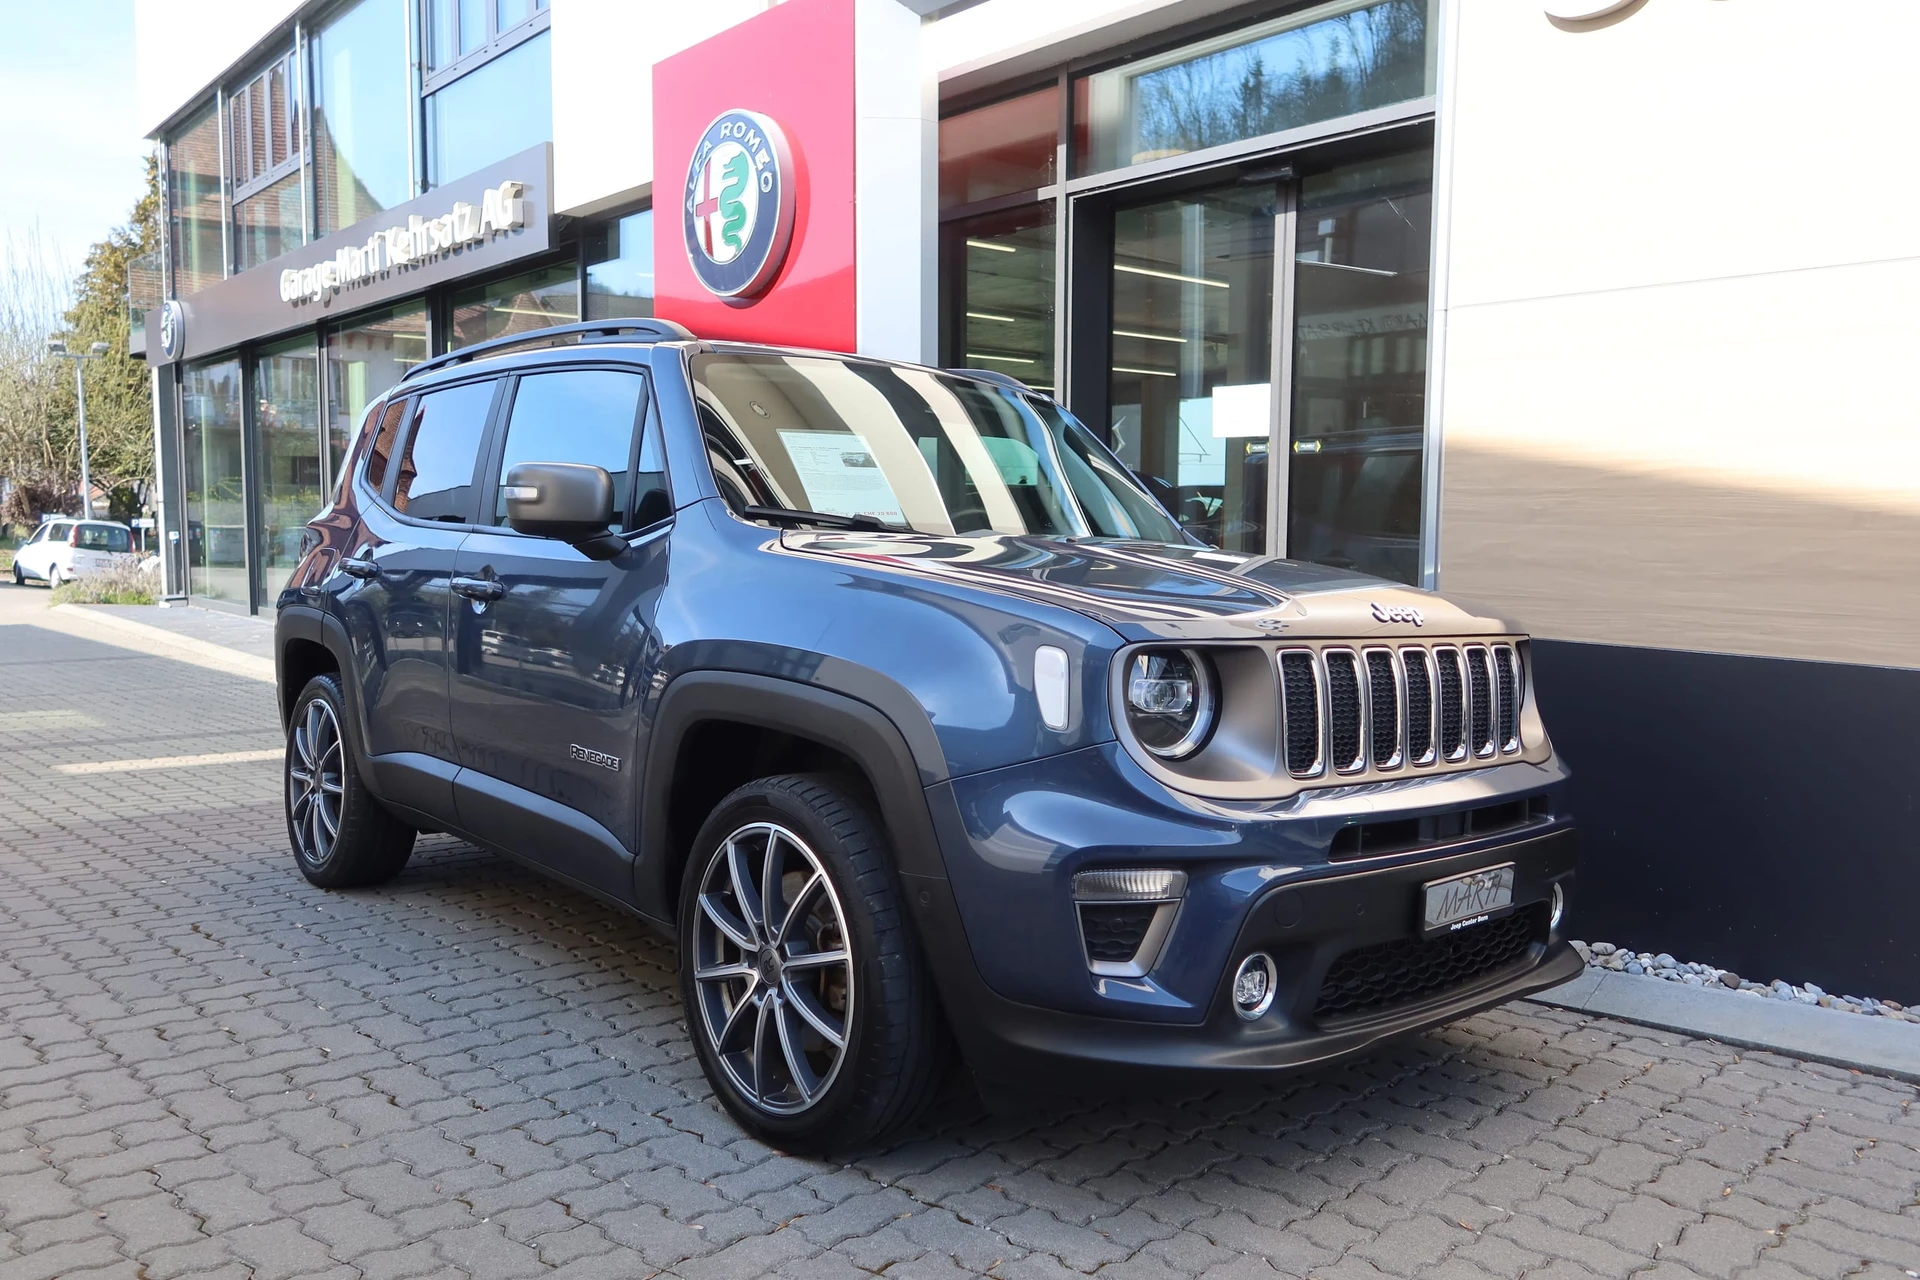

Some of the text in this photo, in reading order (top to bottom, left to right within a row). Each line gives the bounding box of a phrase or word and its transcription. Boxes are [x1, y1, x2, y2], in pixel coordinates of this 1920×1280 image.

[686, 121, 773, 213] ALFA ROMEO
[280, 266, 337, 302] Garage
[384, 201, 483, 268] Kehrsatz
[479, 180, 525, 236] AG
[1370, 602, 1424, 627] Jeep
[570, 743, 621, 772] RENEGADE
[1450, 922, 1462, 930] Jeep
[1462, 918, 1477, 927] Center
